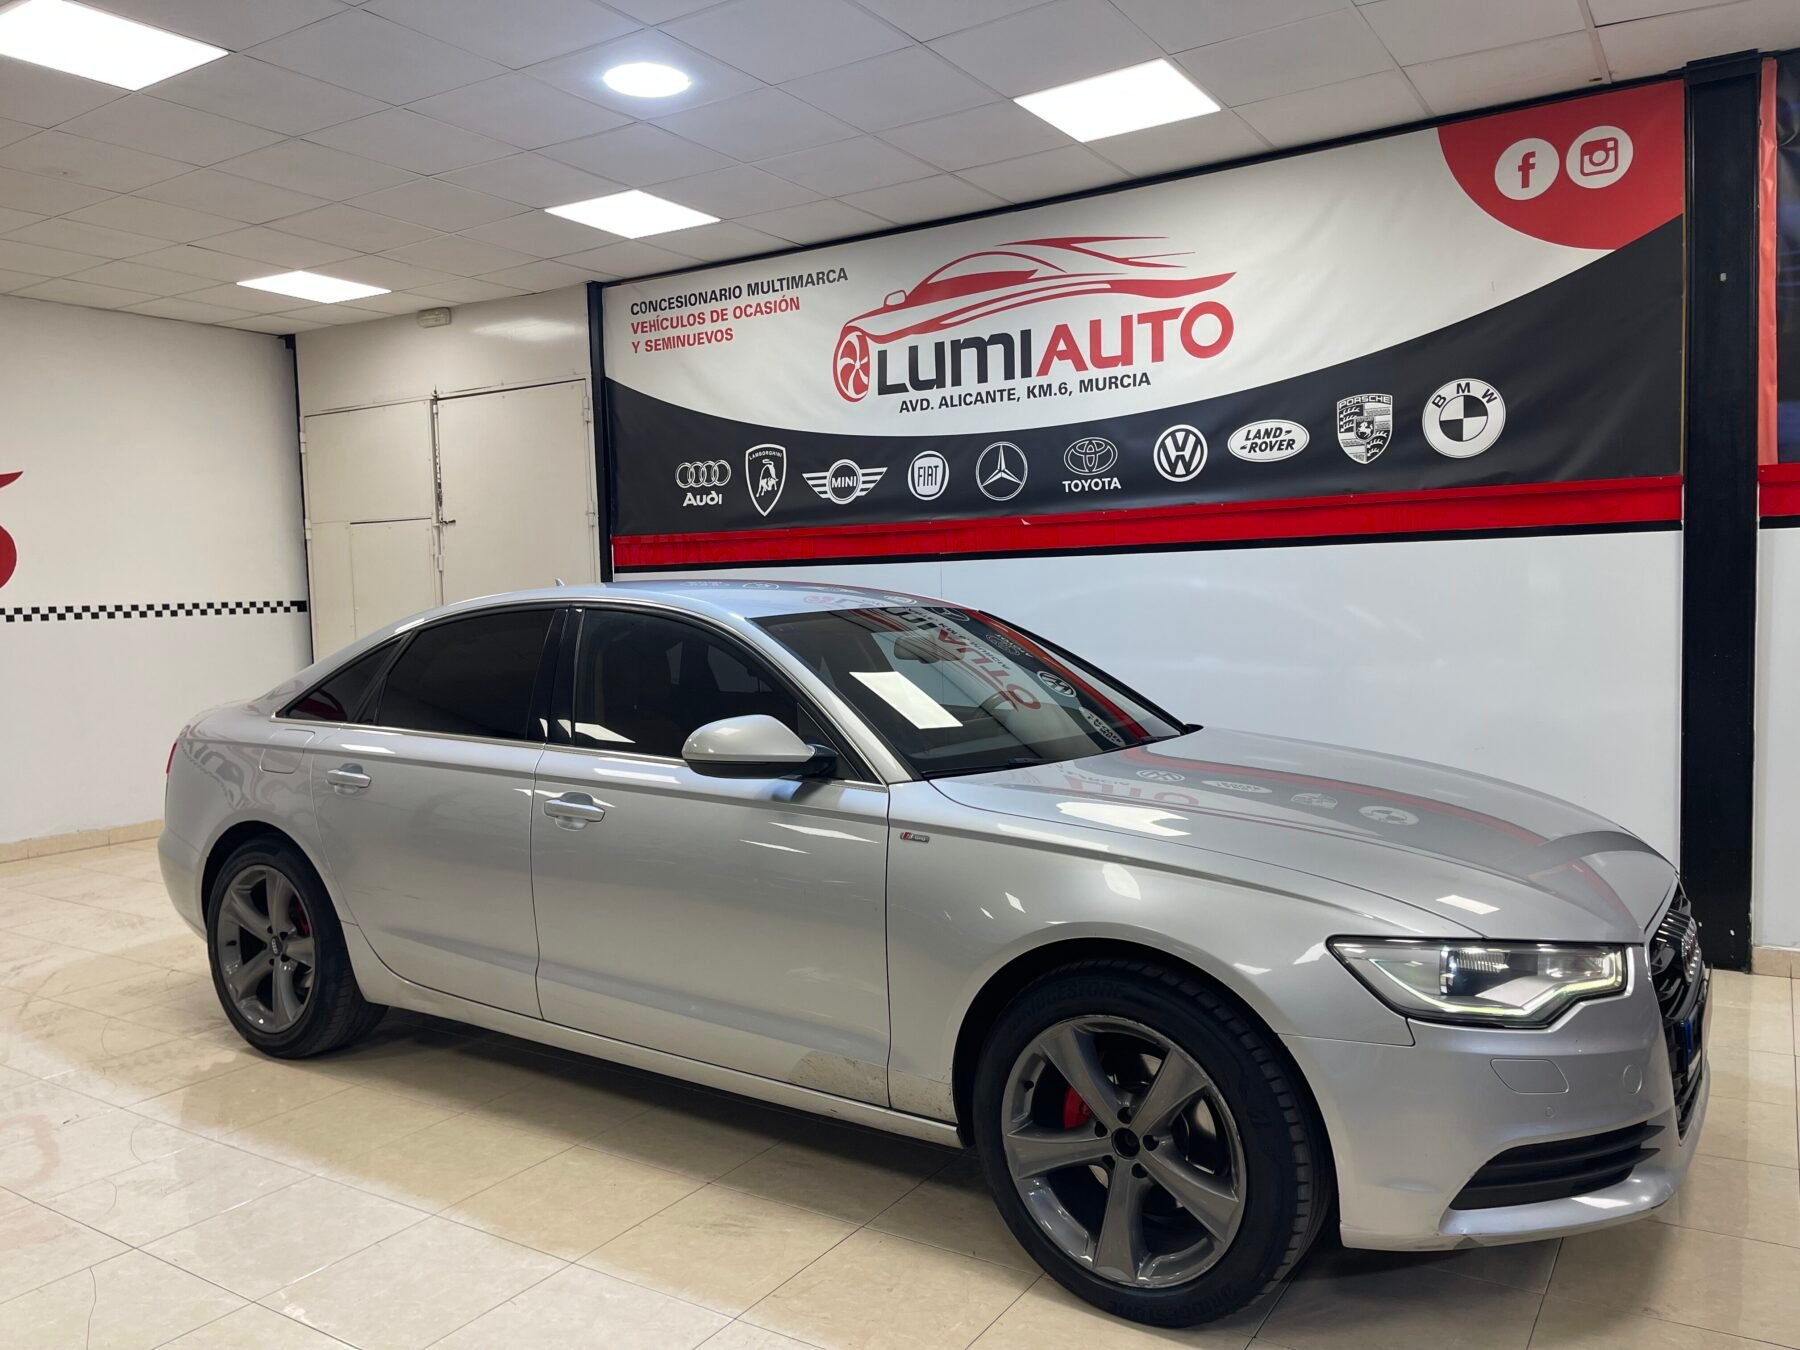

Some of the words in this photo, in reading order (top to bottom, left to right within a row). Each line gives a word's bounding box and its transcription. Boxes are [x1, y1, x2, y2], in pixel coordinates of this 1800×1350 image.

[630, 285, 743, 316] CONCESIONARIO
[746, 267, 849, 297] MULTIMARCA
[630, 311, 706, 335] VEHÍCULOS
[710, 307, 729, 323] DE
[732, 295, 801, 320] OCASIÓN
[631, 340, 640, 354] Y
[644, 327, 734, 353] SEMINUEVOS
[899, 396, 934, 414] AVD.
[938, 388, 1021, 410] ALICANTE,
[1026, 381, 1073, 400] KM.6,
[1078, 372, 1152, 394] MURCIA
[1339, 394, 1391, 409] PORSCHE
[1431, 381, 1498, 410] BMW
[748, 450, 783, 461] LAMBORGHINI
[831, 474, 858, 490] MINI
[917, 465, 940, 488] FIAT
[1062, 477, 1122, 494] TOYOTA
